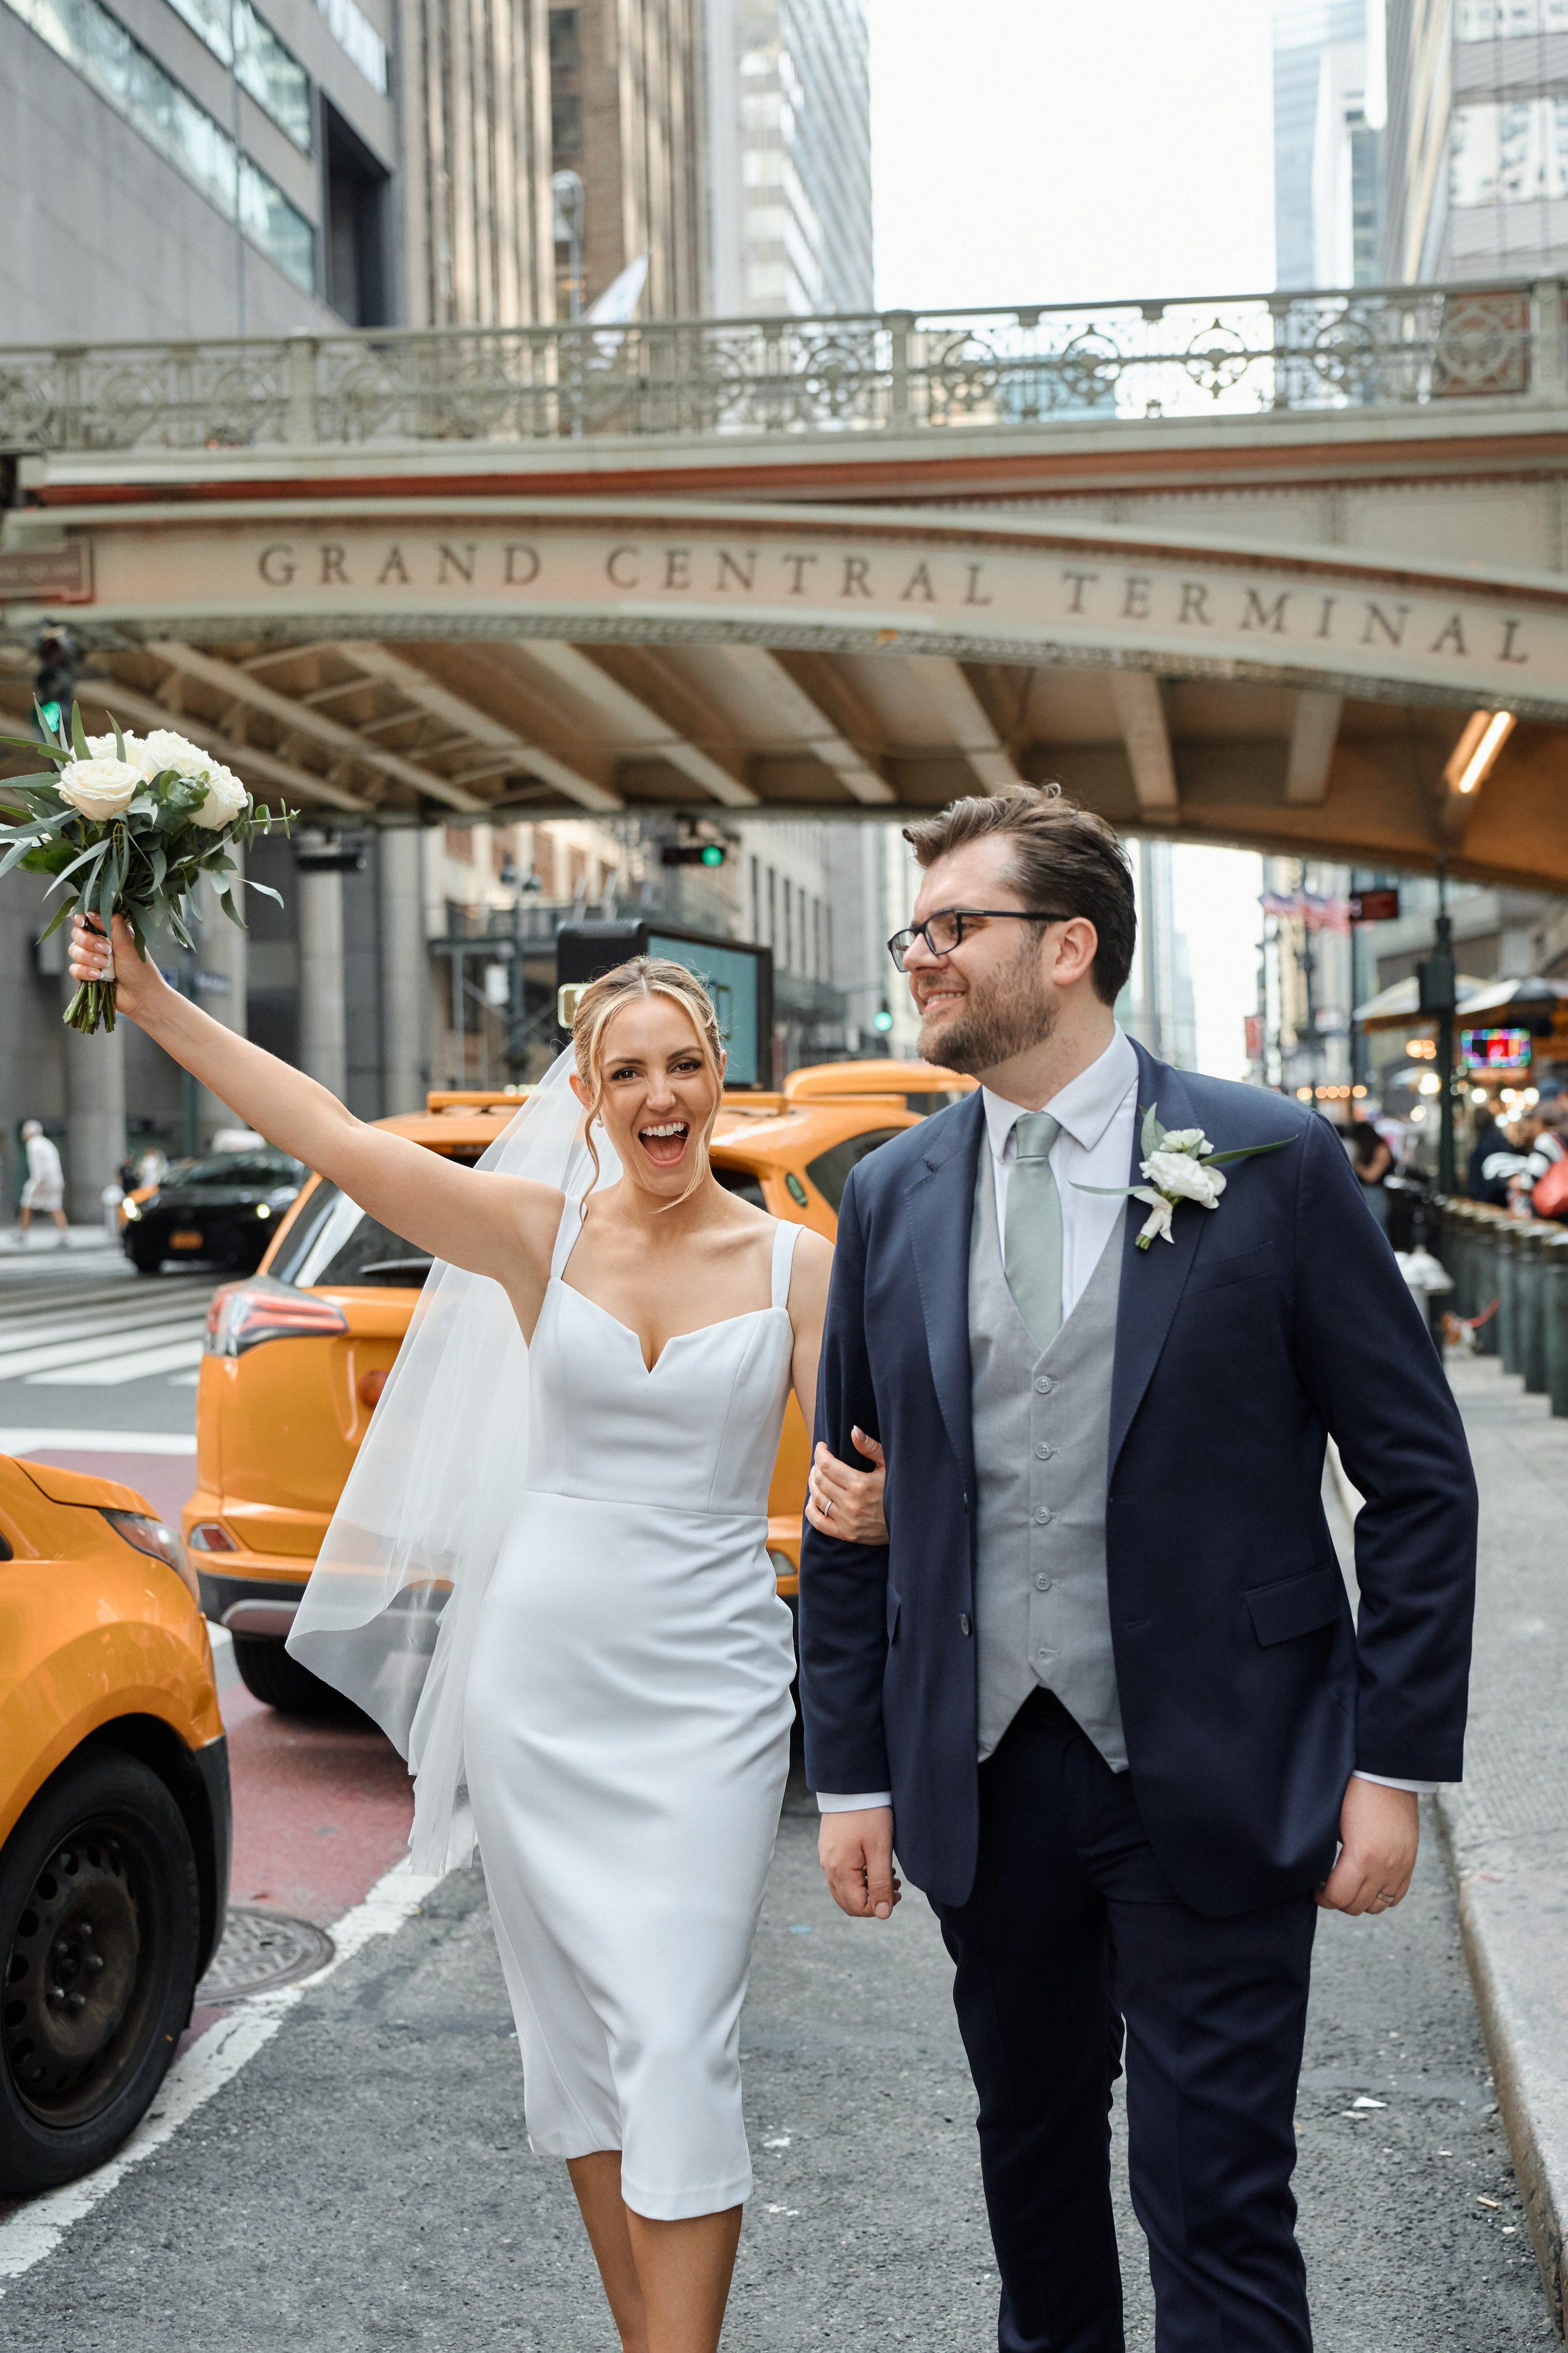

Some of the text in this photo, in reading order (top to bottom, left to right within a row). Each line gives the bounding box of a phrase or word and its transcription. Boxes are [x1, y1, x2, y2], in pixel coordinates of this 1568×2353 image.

[257, 543, 1530, 664] GRAND CENTRAL TERMINAL
